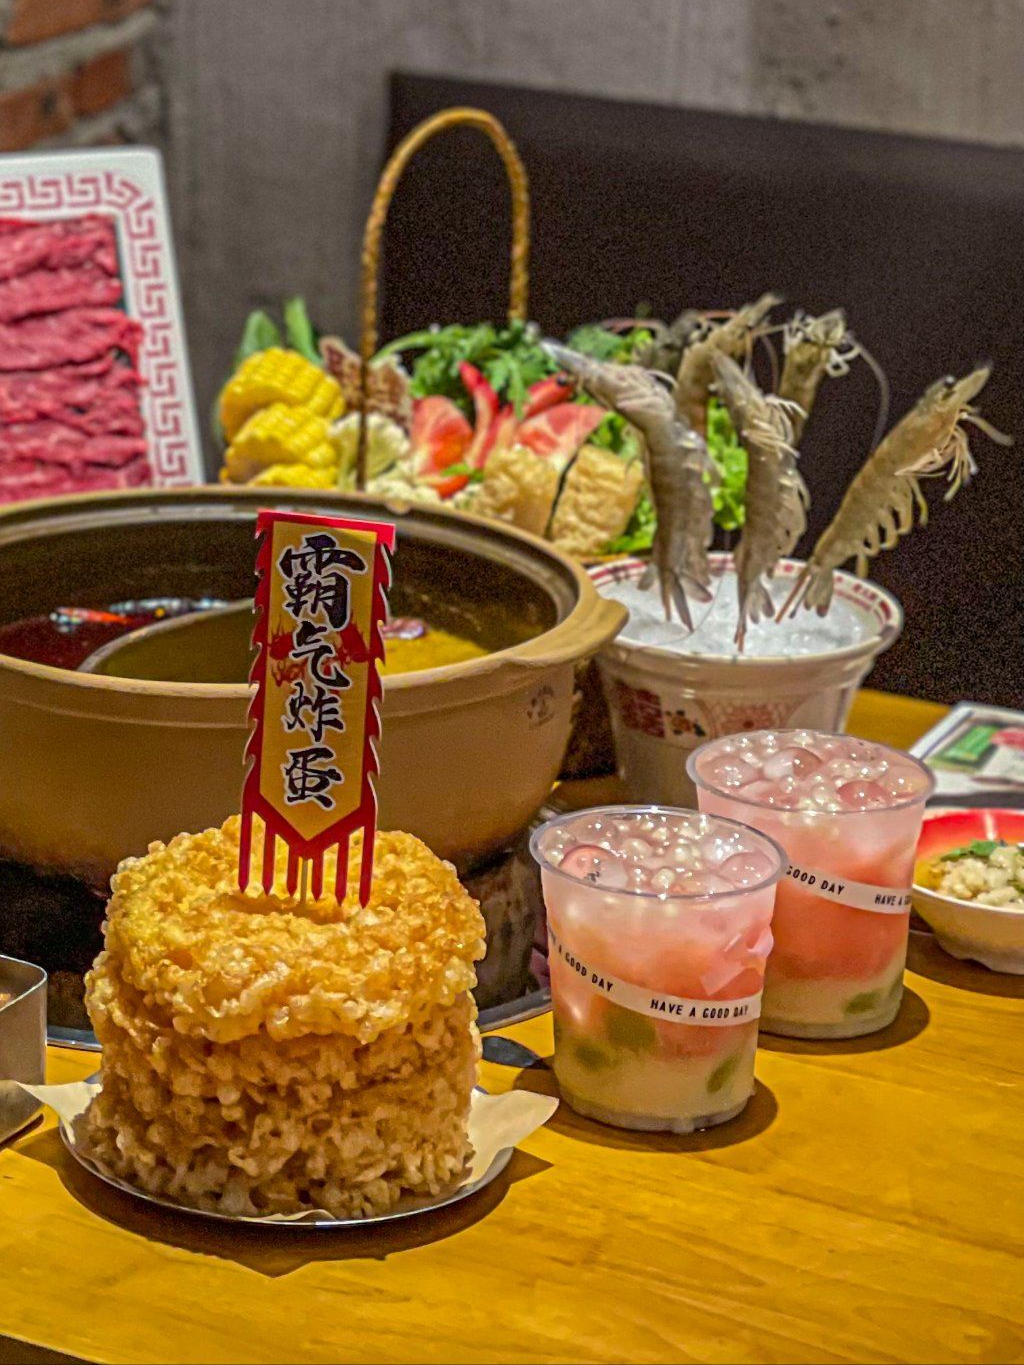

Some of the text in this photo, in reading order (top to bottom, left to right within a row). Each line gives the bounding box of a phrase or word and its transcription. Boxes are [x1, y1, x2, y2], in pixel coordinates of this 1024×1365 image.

[278, 533, 367, 810] 霸气炸蛋
[820, 879, 846, 895] DAY
[875, 894, 896, 906] HAVE
[564, 953, 588, 976] GOOD
[591, 974, 614, 992] DAY
[650, 998, 749, 1019] HAVE A GOOD DAY
